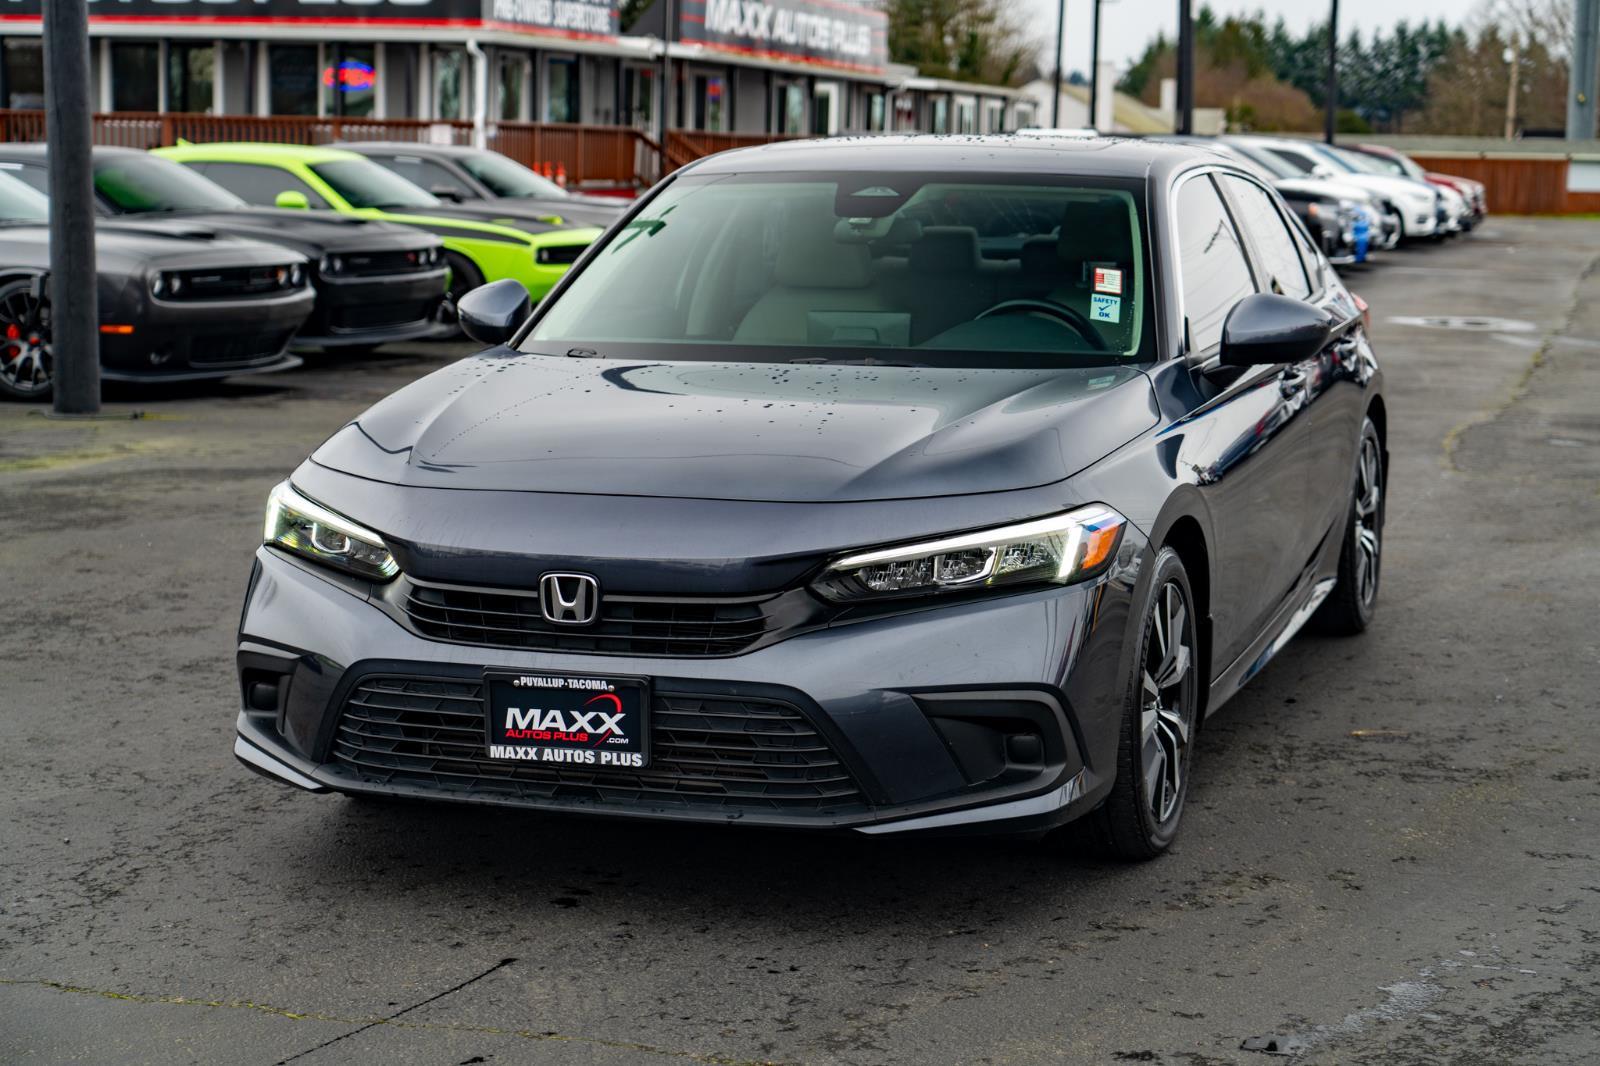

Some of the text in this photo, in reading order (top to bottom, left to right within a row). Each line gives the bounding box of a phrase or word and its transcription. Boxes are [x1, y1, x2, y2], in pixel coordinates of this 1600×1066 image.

[704, 0, 871, 56] MAXX AUTOS PLUS
[1093, 297, 1117, 305] SAFETY
[505, 707, 626, 736] MAXX
[505, 729, 588, 742] AUTOS PLUS
[490, 745, 643, 767] MAXX AUTOS PLUS
